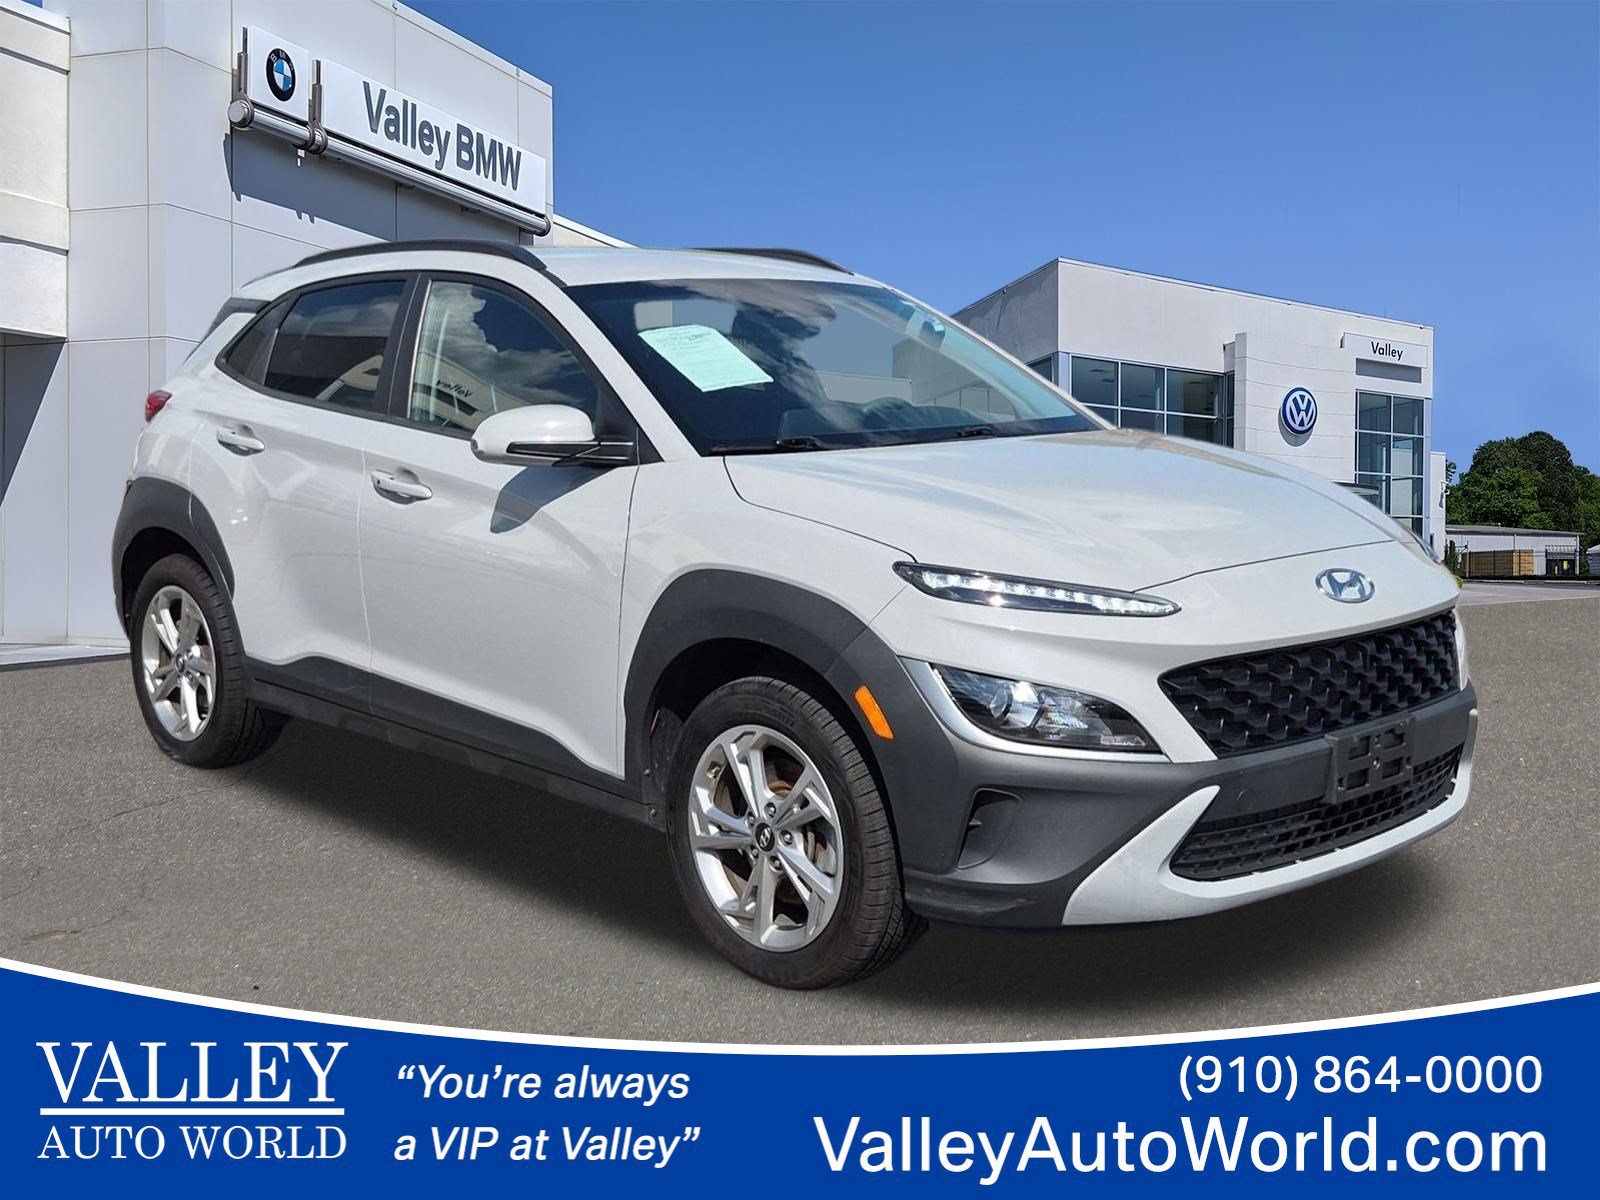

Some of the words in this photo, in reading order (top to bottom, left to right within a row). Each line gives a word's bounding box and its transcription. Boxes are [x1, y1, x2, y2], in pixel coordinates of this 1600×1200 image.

[362, 80, 451, 171] Valley
[456, 123, 522, 191] BMW
[1370, 341, 1404, 361] Valley
